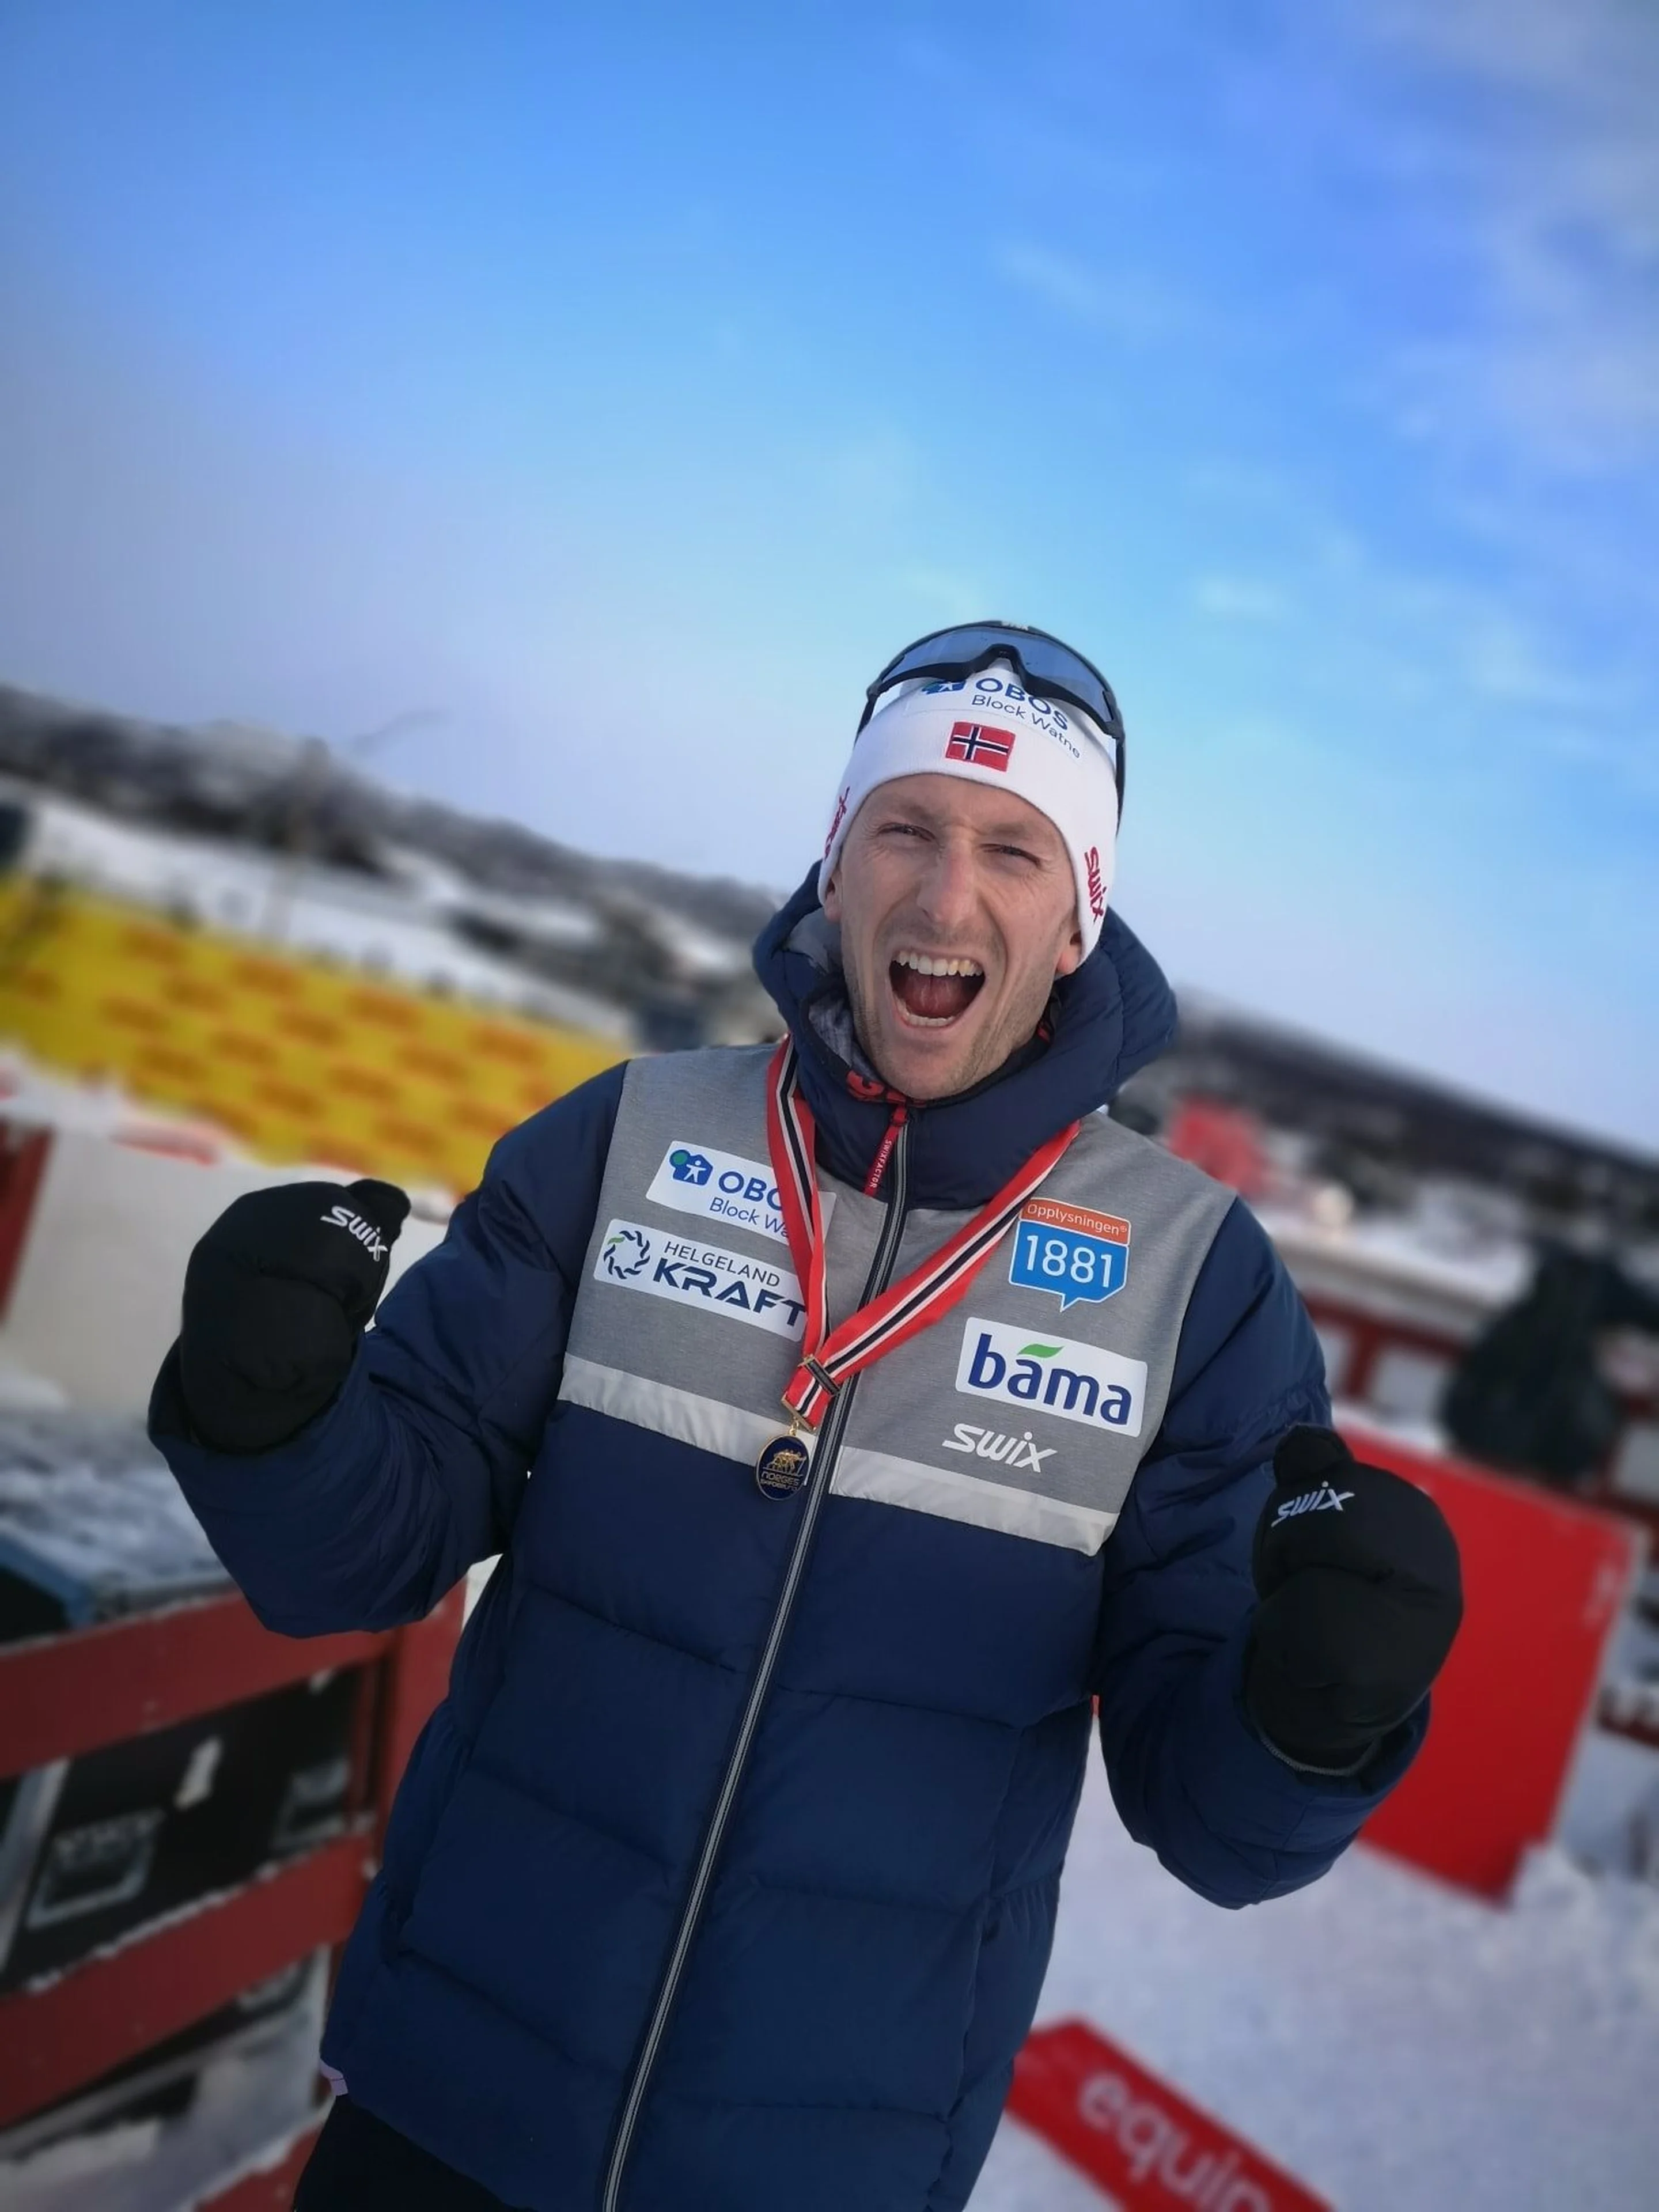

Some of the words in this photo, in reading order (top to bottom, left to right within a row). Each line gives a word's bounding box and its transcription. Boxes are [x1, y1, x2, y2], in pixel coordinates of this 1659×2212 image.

[971, 694, 1027, 719] Block
[1031, 713, 1081, 759] Watne
[975, 677, 1068, 730] OBOS
[709, 1197, 757, 1226] Block
[718, 1171, 783, 1211] OBO
[663, 1241, 781, 1287] HELGELAND
[1026, 1234, 1113, 1288] 1881
[653, 1257, 806, 1327] KRAFT
[968, 1332, 1132, 1426] bama
